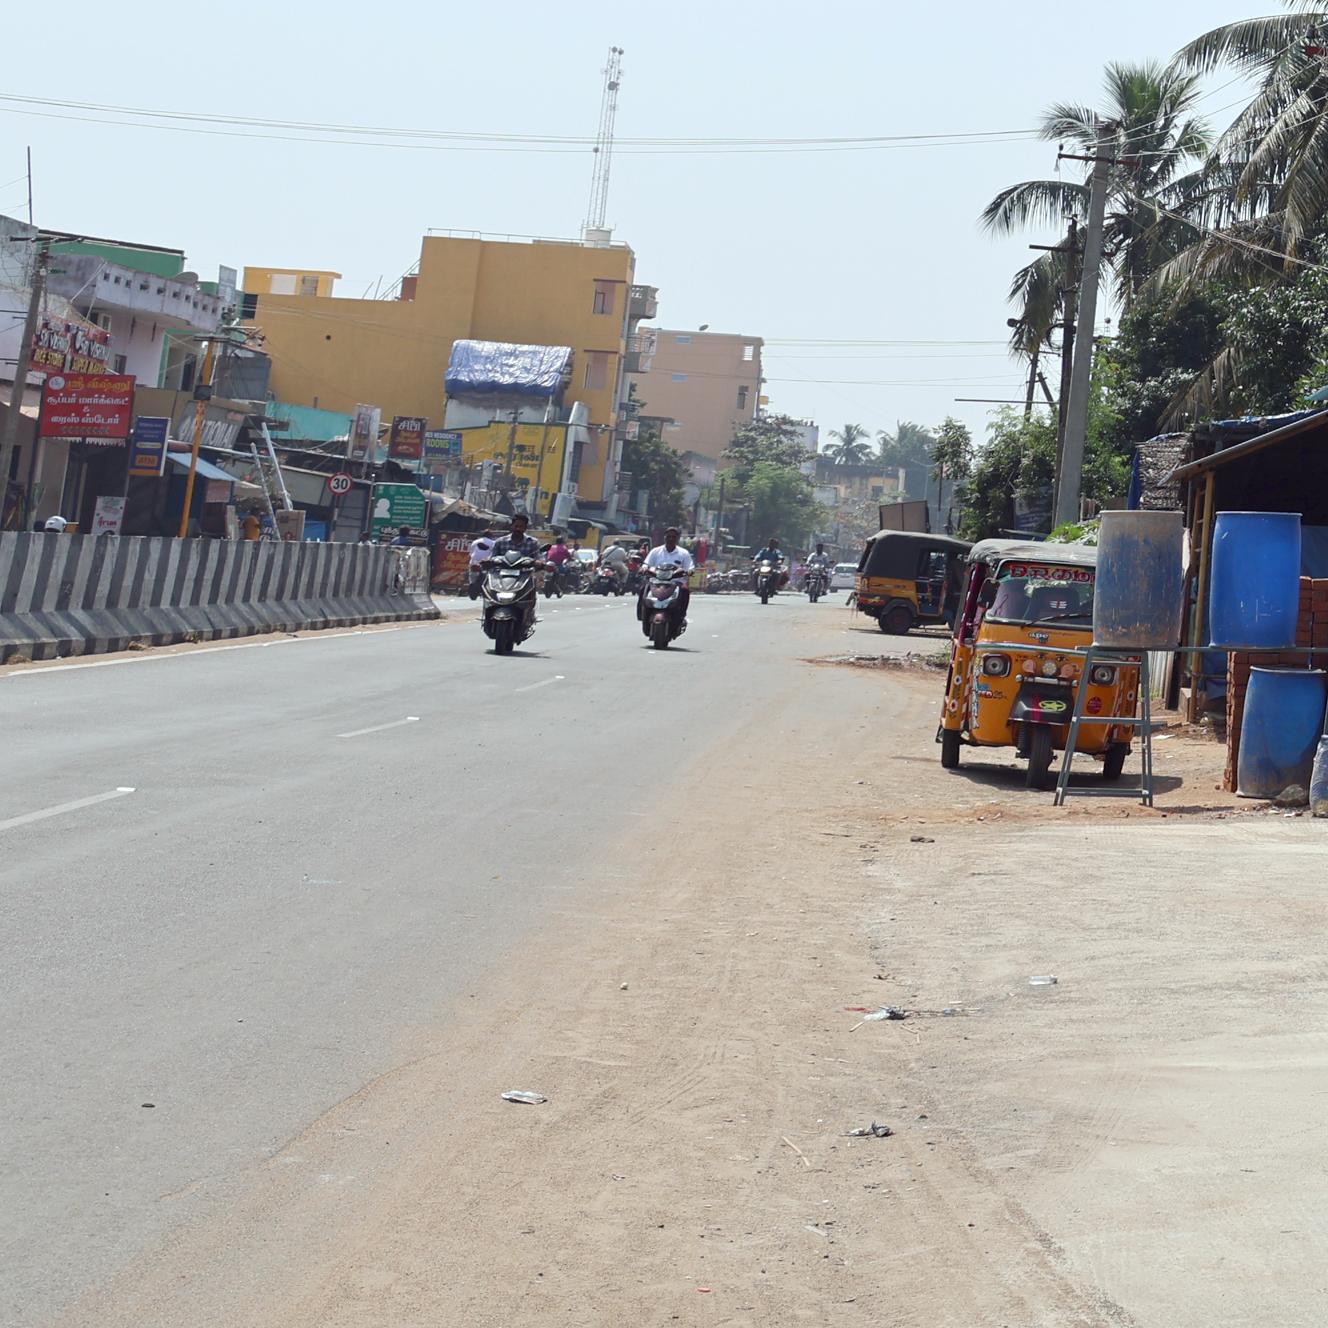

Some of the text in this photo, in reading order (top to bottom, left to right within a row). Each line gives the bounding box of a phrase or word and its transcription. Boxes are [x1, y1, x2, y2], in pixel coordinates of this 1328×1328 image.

[47, 393, 129, 405] சூப்பர் மார்க்கெட்
[51, 413, 120, 424] ரைஸ் ஸ்டோர்
[332, 478, 349, 491] 30
